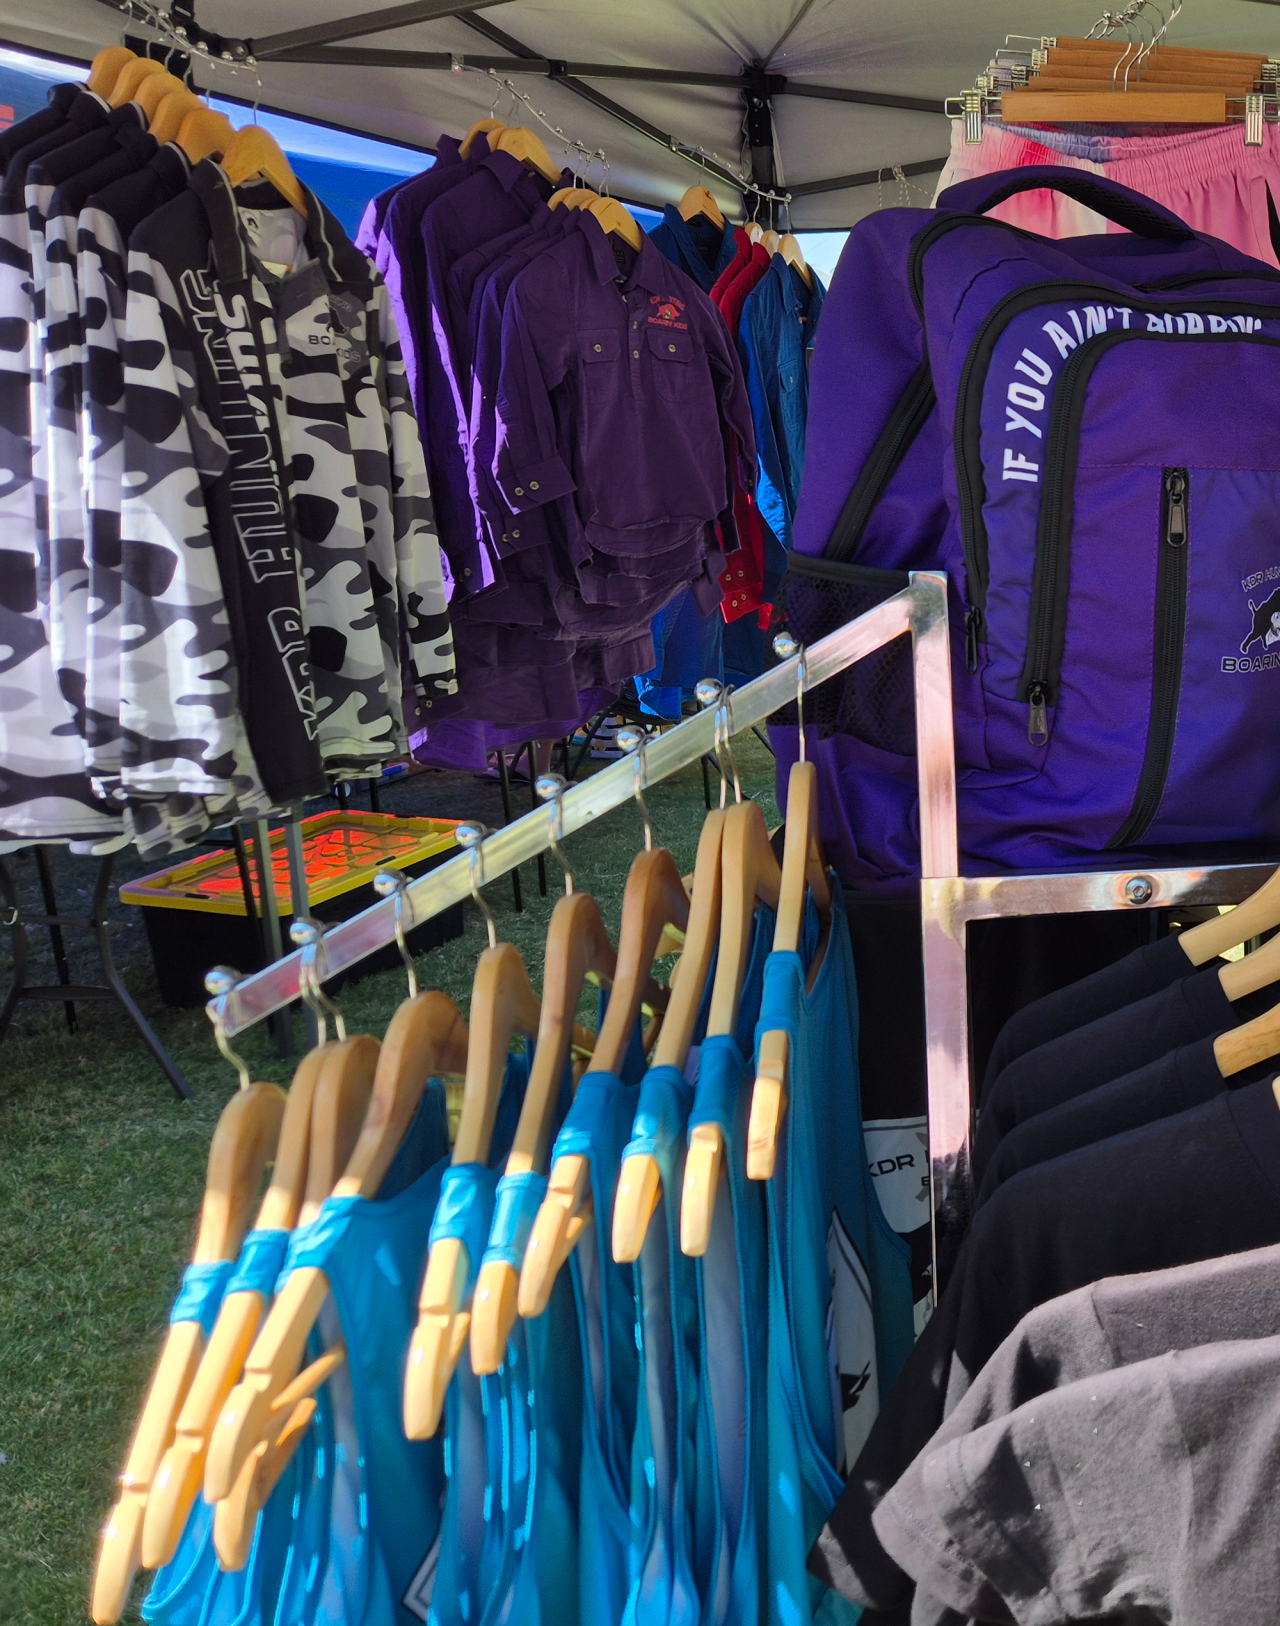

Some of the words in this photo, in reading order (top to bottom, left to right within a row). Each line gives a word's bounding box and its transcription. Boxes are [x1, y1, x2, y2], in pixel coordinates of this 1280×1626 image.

[1042, 305, 1133, 360] AIN'T
[1005, 348, 1053, 439] YOU
[1002, 448, 1039, 482] IF
[1241, 571, 1264, 592] KDR
